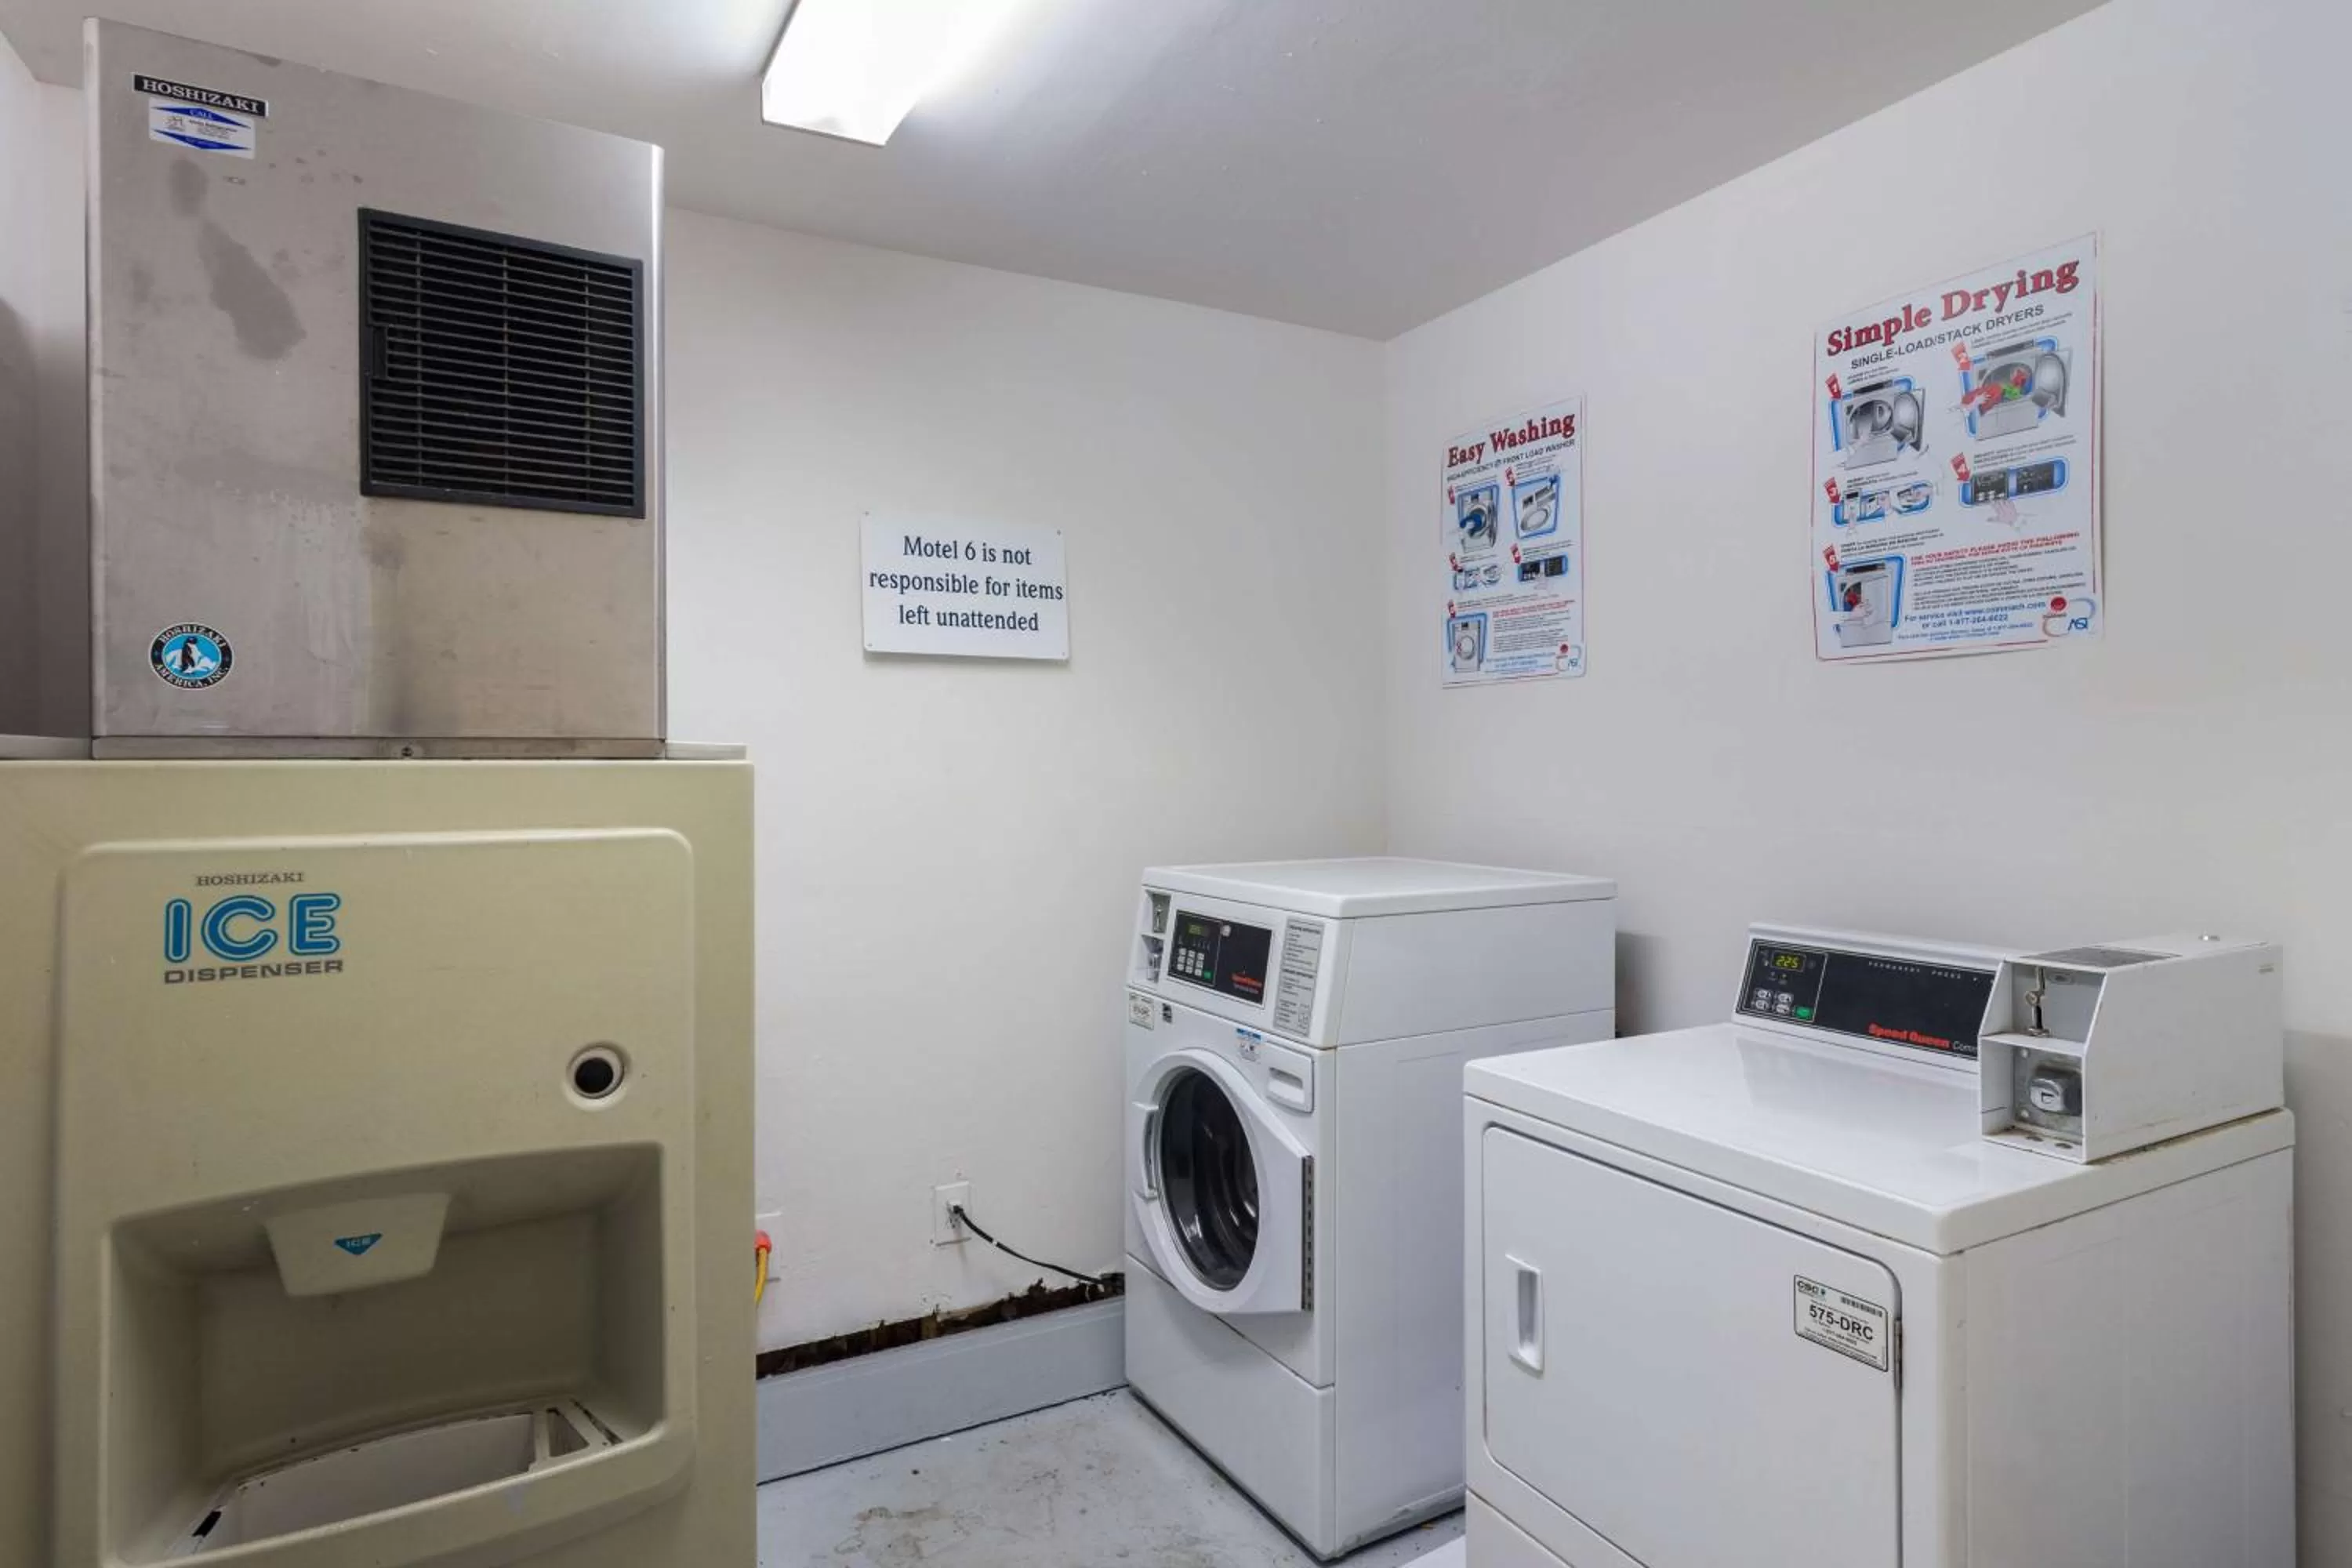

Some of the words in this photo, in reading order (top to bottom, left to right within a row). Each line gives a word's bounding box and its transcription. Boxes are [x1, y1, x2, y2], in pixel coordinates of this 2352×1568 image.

[142, 78, 259, 113] HOSHIZAKI
[1827, 303, 1932, 356] Simple
[1940, 260, 2080, 321] Drying
[1985, 303, 2045, 331] DRYERS
[1447, 442, 1486, 468] Easy
[1490, 414, 1575, 453] Washing
[903, 535, 958, 560] Motel
[964, 542, 976, 561] 6
[982, 543, 996, 562] is
[1003, 547, 1033, 565] not
[869, 572, 979, 594] responsible
[985, 576, 1011, 597] for
[1016, 579, 1063, 600] items
[899, 605, 931, 626] left
[937, 611, 1039, 631] unattended
[159, 626, 227, 648] HOSHIZAKI
[197, 872, 305, 886] HOSHIZAKI
[165, 893, 341, 963] ICE
[164, 960, 343, 984] DISPENSER
[1869, 1022, 1907, 1041] Speed
[1909, 1031, 1950, 1049] Queen
[1809, 1305, 1873, 1340] 575-DRC
